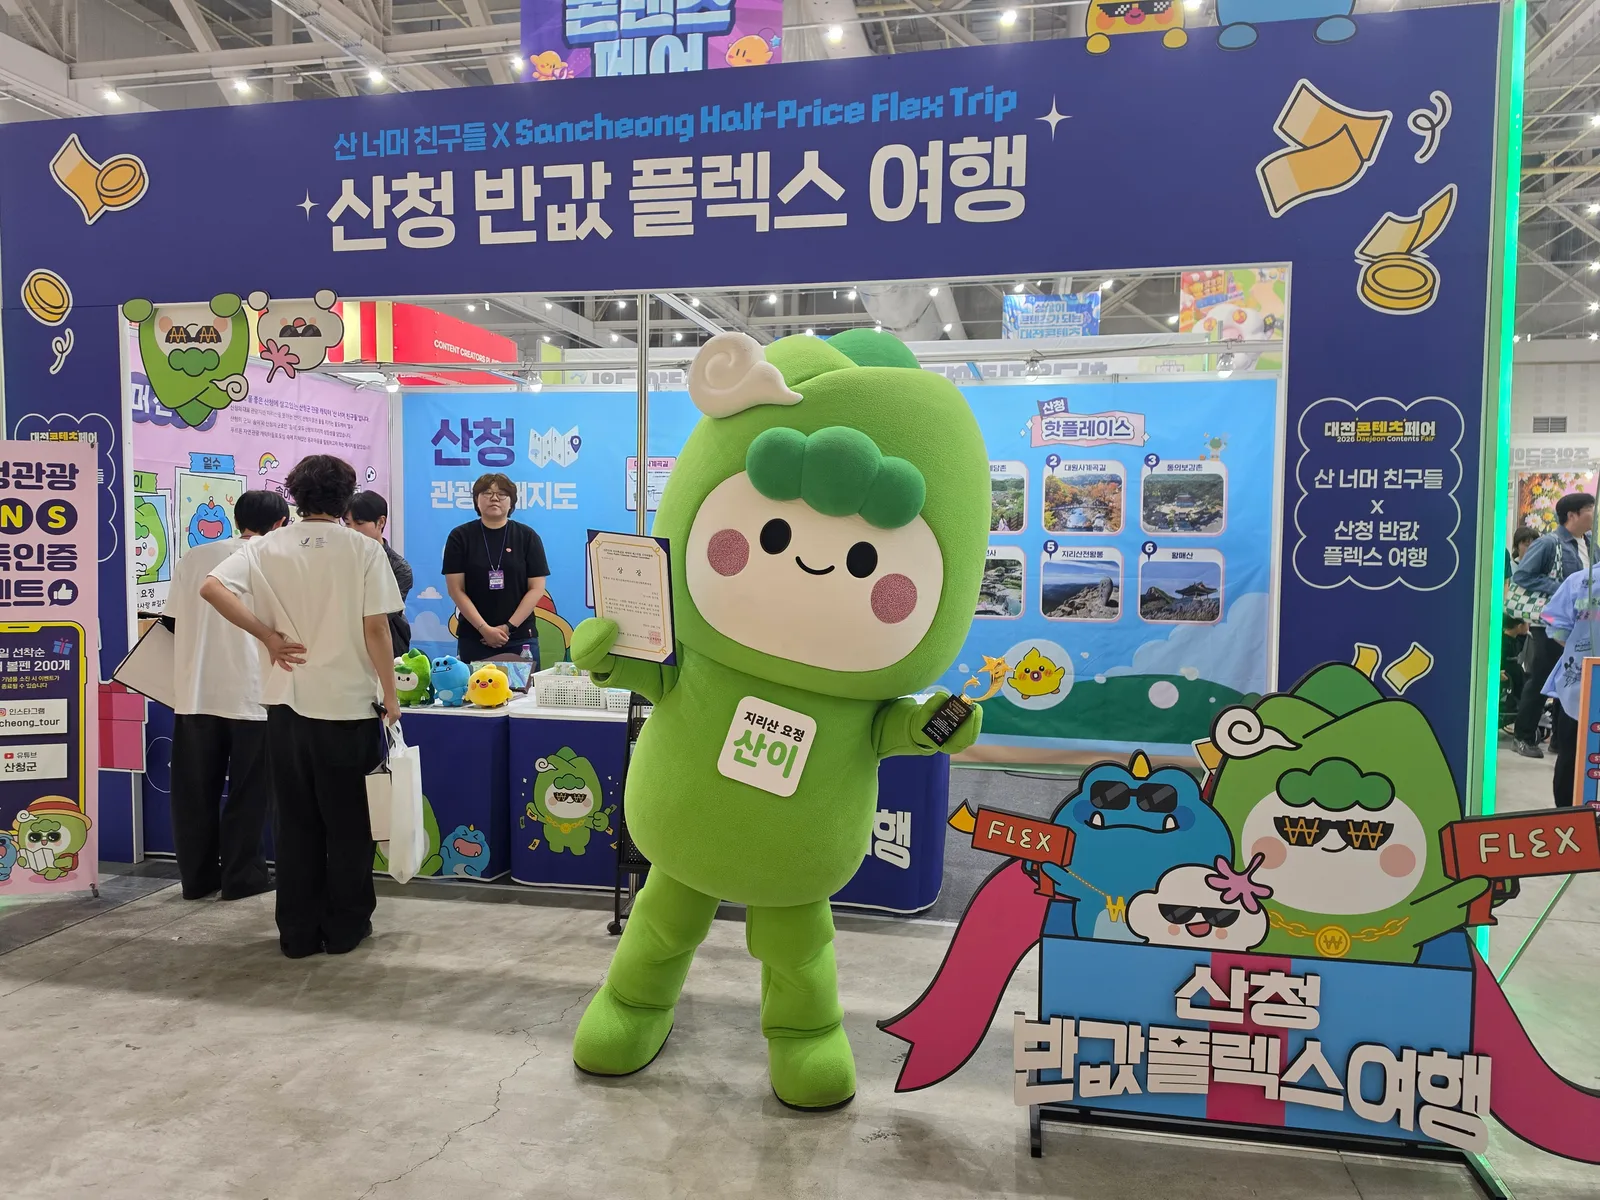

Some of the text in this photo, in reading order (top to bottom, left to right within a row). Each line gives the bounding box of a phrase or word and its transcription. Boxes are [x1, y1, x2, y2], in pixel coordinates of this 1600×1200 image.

[333, 132, 357, 161] 산
[362, 128, 409, 158] 너머
[413, 121, 487, 155] 친구들
[515, 112, 694, 144] Sancheong
[700, 99, 865, 134] Half-Price
[871, 90, 943, 123] Flex
[949, 85, 1018, 123] Trip
[326, 134, 1027, 252] 산청 반값 플렉스 여행
[434, 339, 460, 355] CONTENT
[460, 348, 485, 363] CREATORS
[1043, 400, 1065, 413] 산청
[1044, 419, 1131, 438] 핫플레이스
[1324, 421, 1436, 437] 대전콘텐츠페어
[431, 417, 516, 467] 산청
[1049, 456, 1058, 465] 2
[1148, 455, 1157, 465] 3
[1314, 468, 1443, 489] 산 너머 친구들
[1334, 520, 1420, 542] 산청 반값
[1047, 542, 1055, 551] 5
[1145, 543, 1153, 553] 6
[1323, 546, 1428, 567] 플렉스 여행
[141, 588, 155, 598] 요정
[13, 648, 45, 658] 선착순
[6, 661, 31, 672] 볼펜
[34, 660, 70, 671] 200개
[9, 708, 45, 716] 인스타그램
[744, 711, 806, 743] 지리산 요정
[733, 729, 799, 779] 산이
[4, 762, 37, 773] 산청군
[866, 809, 911, 869] 행
[987, 821, 1051, 852] FLEX
[1480, 826, 1581, 863] FLEX
[1174, 963, 1321, 1031] 산청
